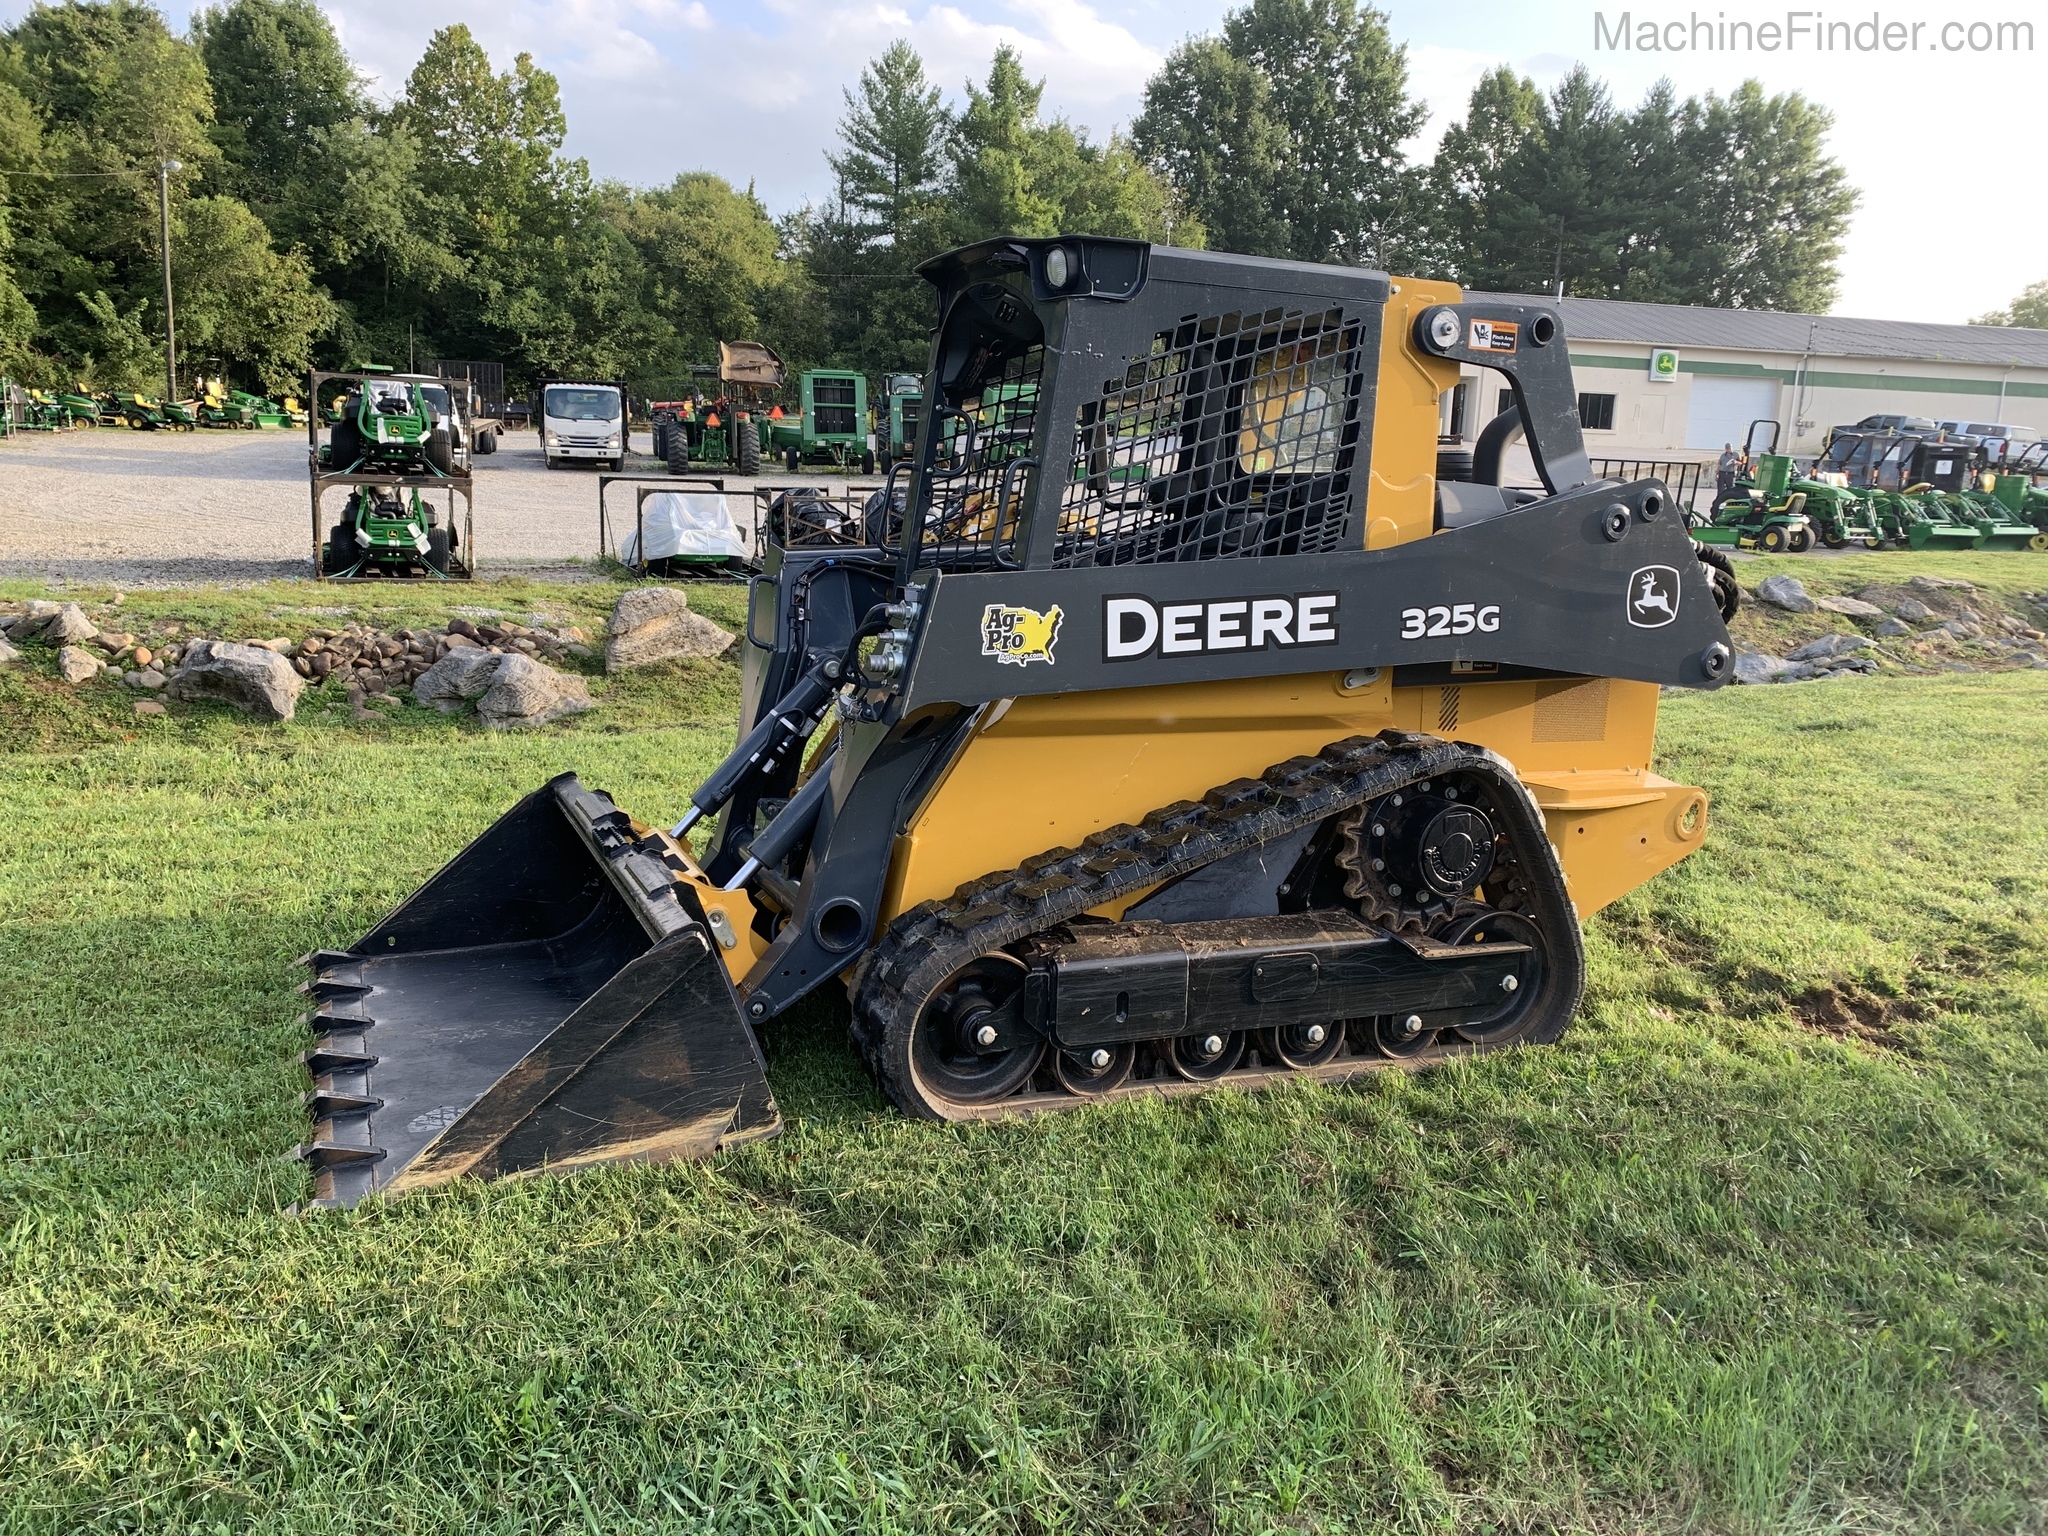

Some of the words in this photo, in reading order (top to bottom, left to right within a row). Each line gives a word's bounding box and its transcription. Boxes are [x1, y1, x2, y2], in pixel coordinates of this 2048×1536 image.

[1492, 333, 1504, 341] Pinch
[986, 608, 1024, 632] Ag-
[1107, 595, 1337, 657] DEERE
[1401, 603, 1500, 639] 325G
[986, 630, 1025, 651] Pro
[999, 652, 1044, 662] AgProCo.com
